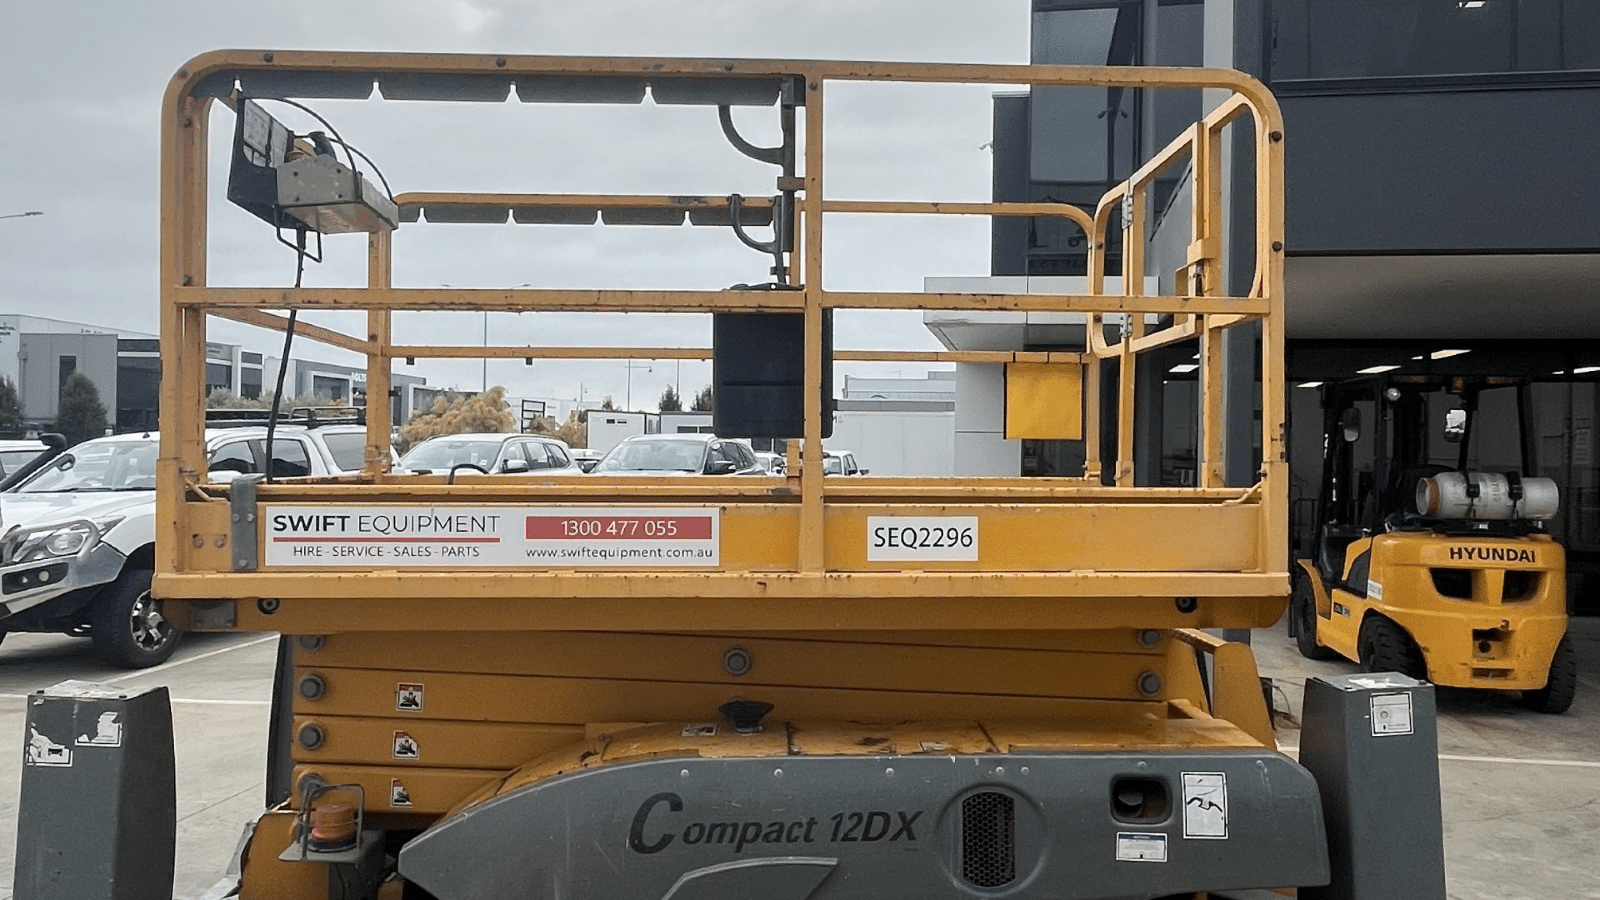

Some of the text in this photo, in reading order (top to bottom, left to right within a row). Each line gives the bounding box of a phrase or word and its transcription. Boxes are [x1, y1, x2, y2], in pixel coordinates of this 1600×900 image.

[273, 514, 501, 536] SWIFT EQUIPMENT
[561, 520, 678, 536] 1300 477 055
[874, 527, 973, 550] SEQ2296
[293, 545, 480, 558] HIRE SERVICE SALES PARTS
[525, 546, 713, 560] www.swiftequipment.com.au
[1449, 547, 1536, 563] HYUNDAI
[629, 792, 923, 854] Compact 12DX
